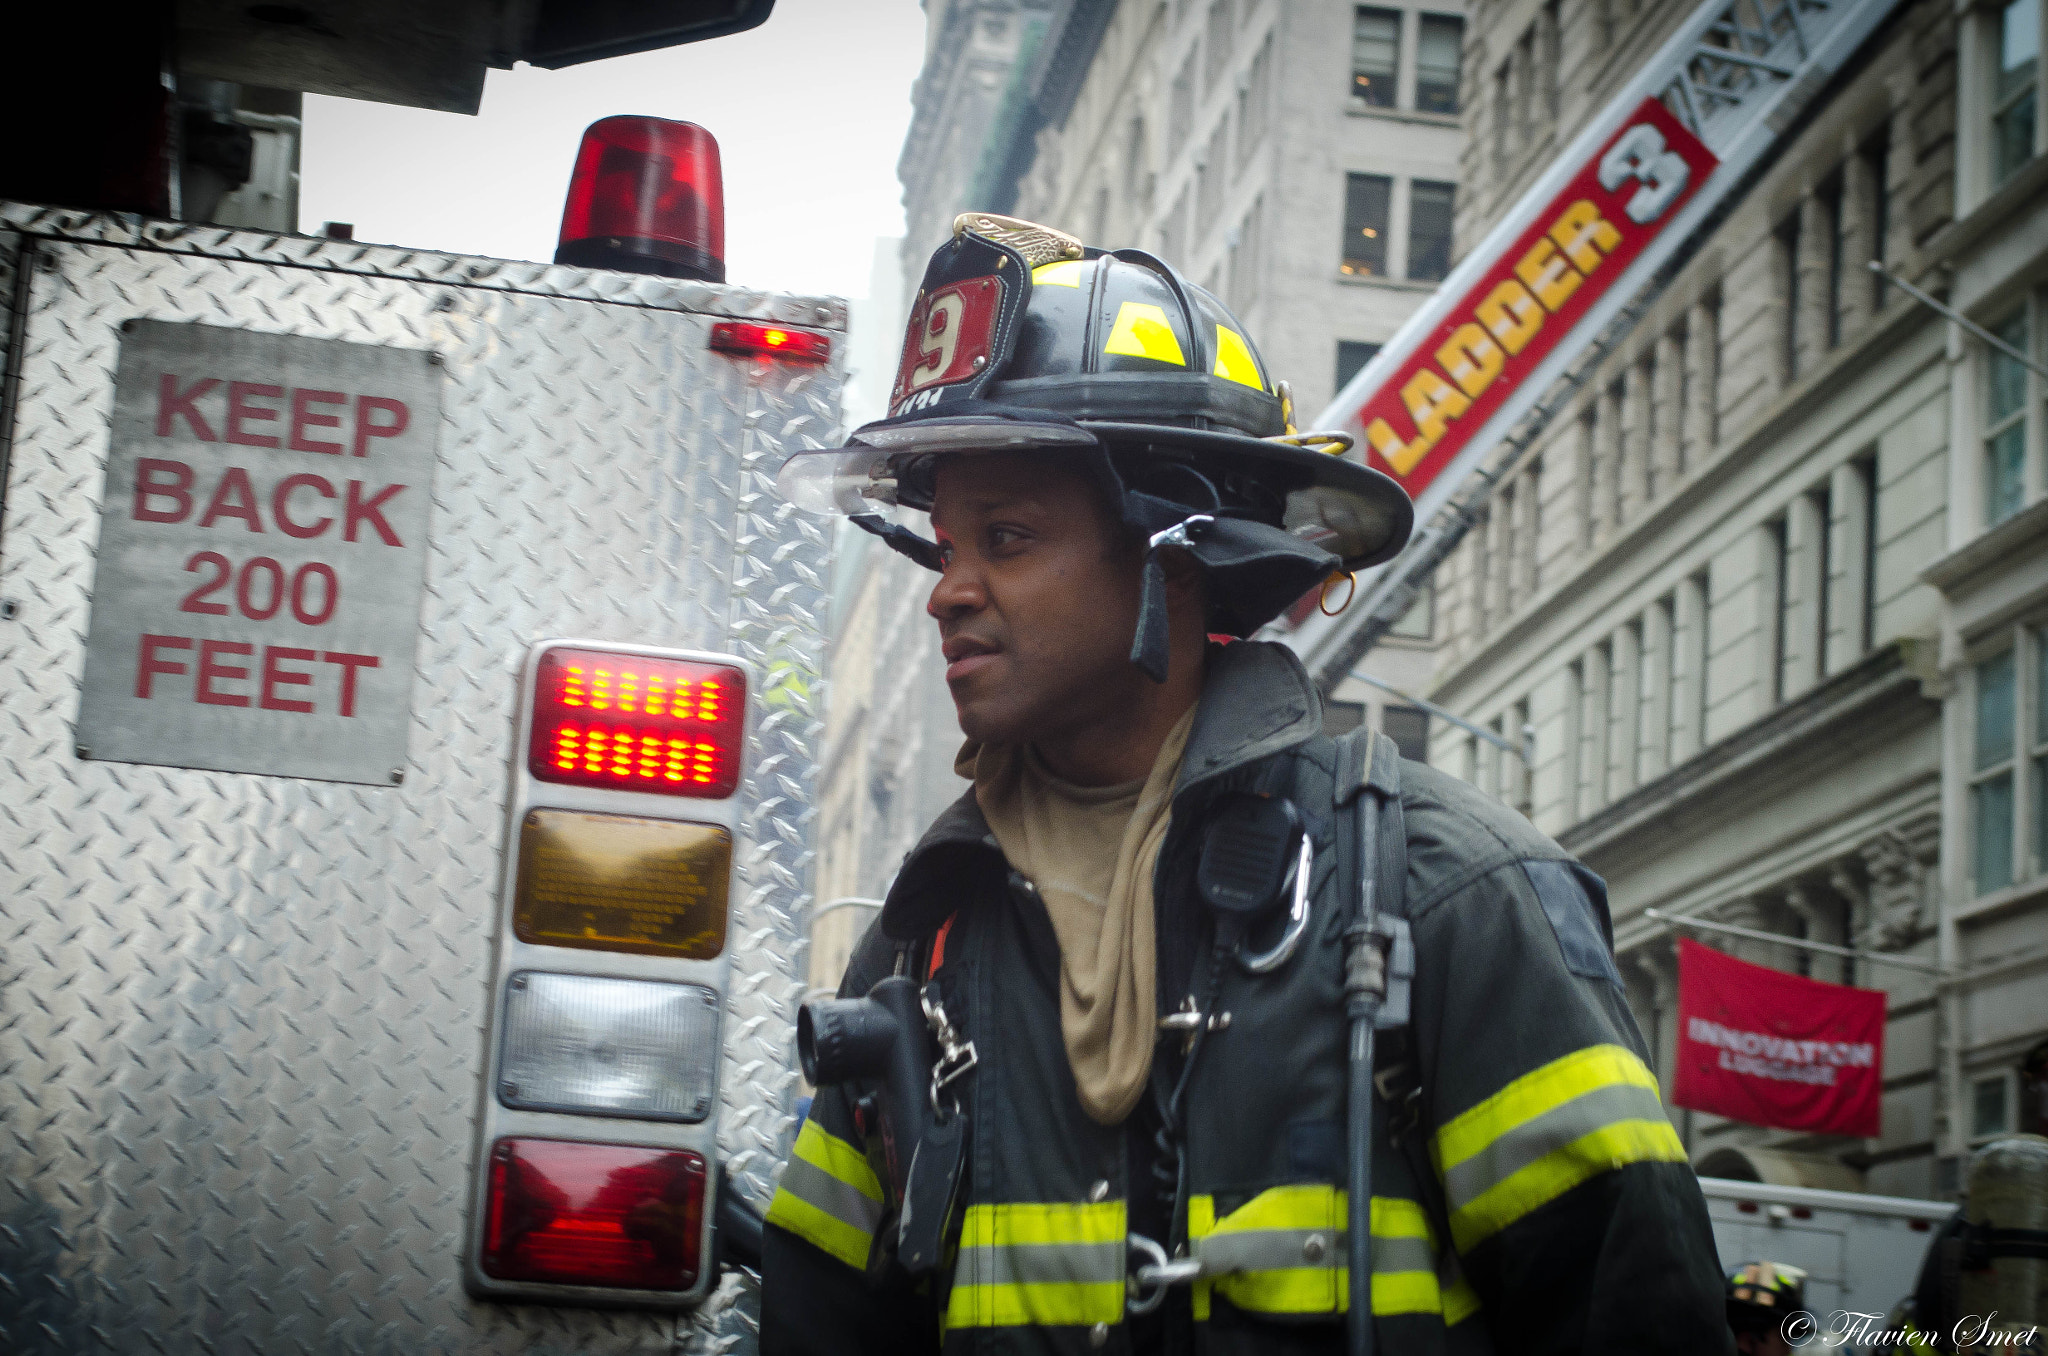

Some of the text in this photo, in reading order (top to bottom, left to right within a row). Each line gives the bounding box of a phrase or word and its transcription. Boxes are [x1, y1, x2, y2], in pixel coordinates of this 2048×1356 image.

[911, 292, 964, 388] 9
[1365, 122, 1692, 478] LADDER 3
[154, 373, 411, 458] KEEP
[131, 457, 406, 548] BACK
[180, 550, 339, 626] 200
[134, 633, 382, 718] FEET
